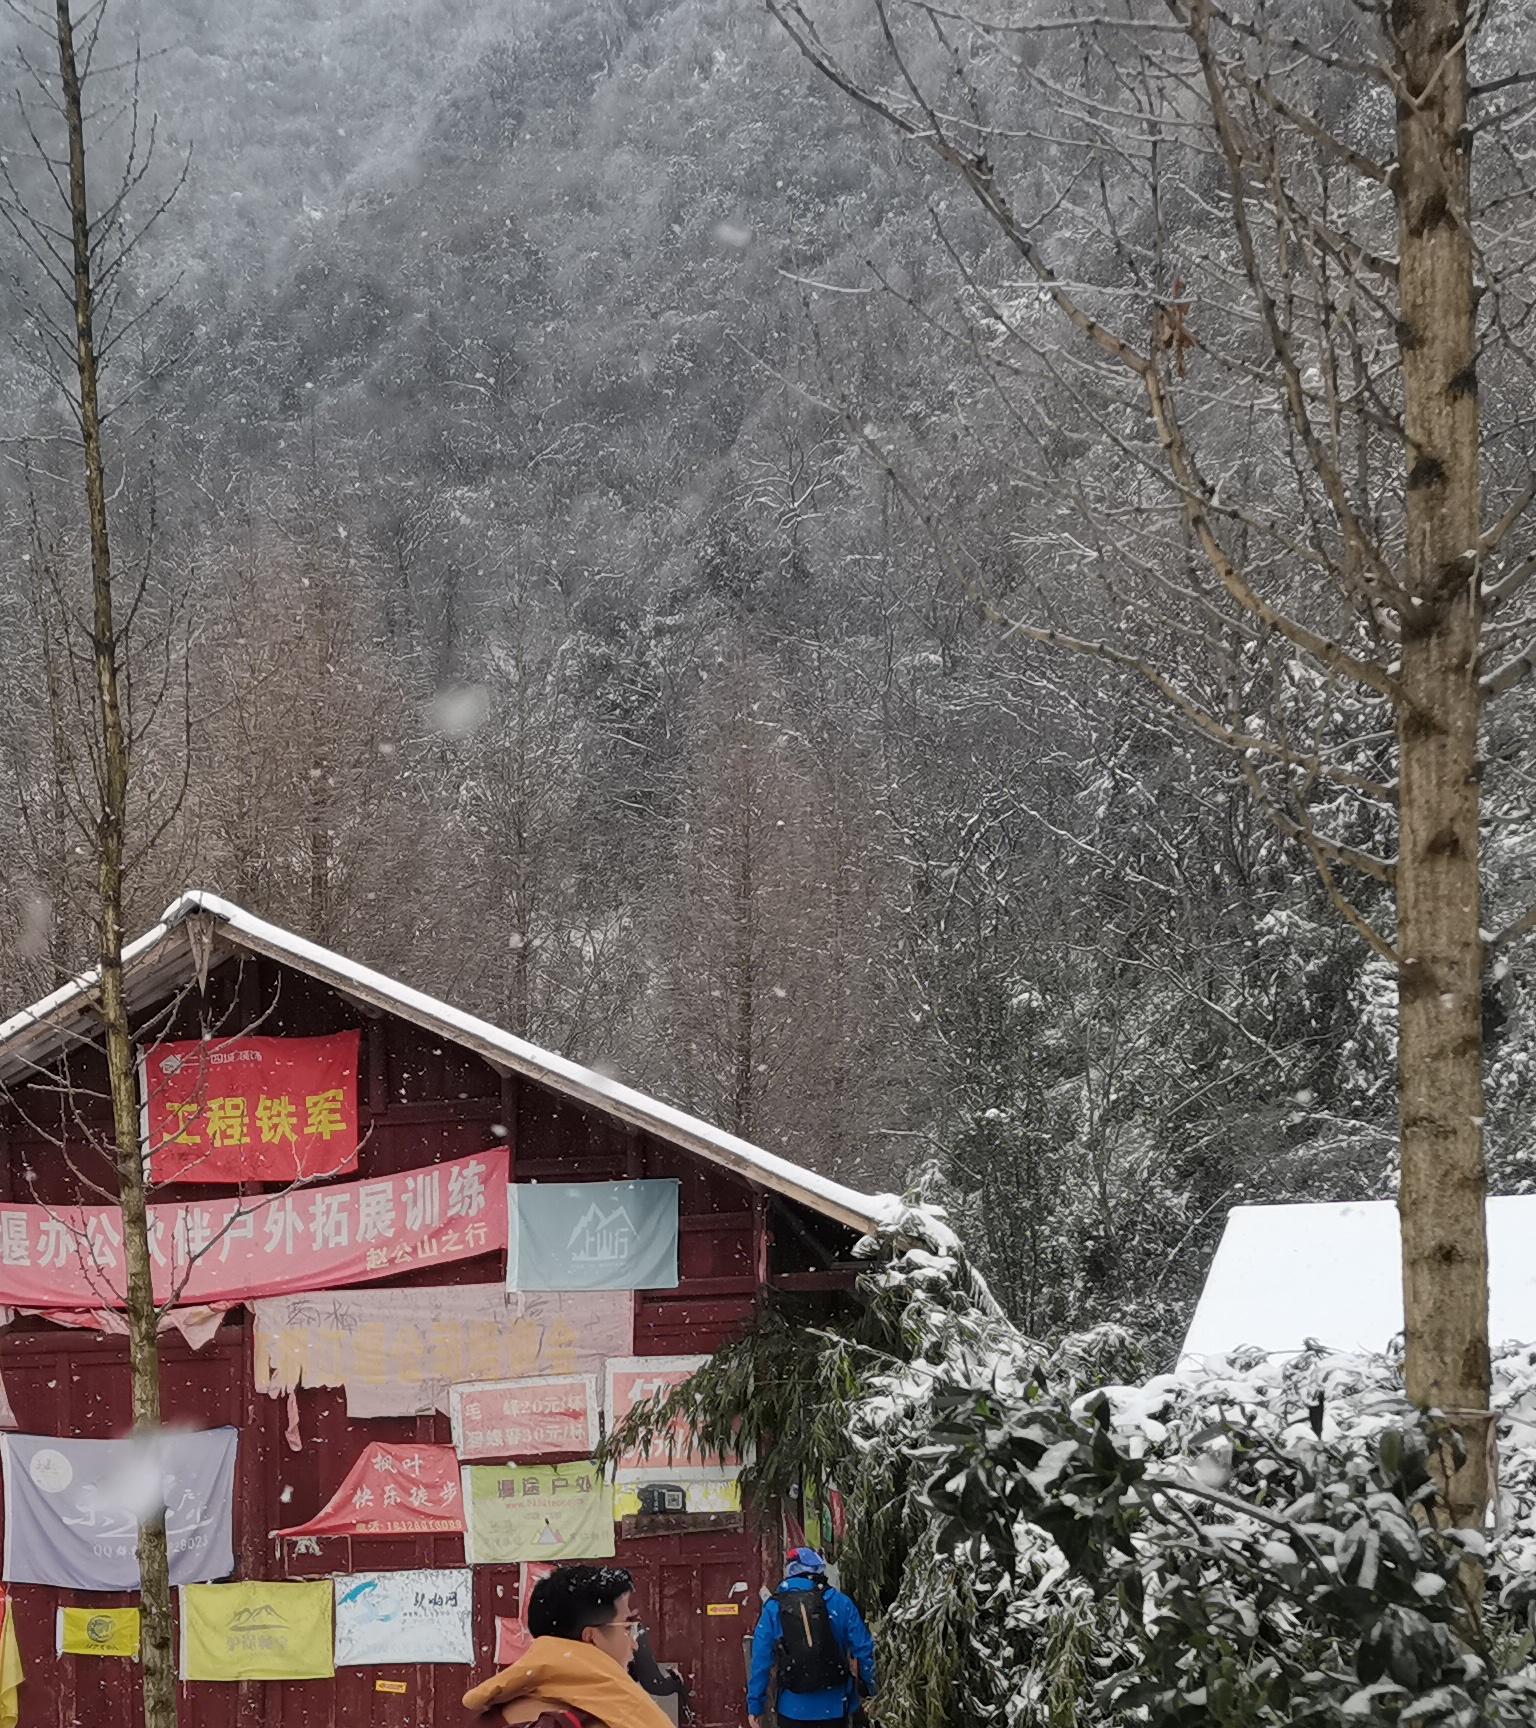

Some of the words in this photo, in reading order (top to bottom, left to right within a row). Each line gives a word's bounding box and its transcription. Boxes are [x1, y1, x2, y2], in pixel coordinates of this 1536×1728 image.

[162, 1088, 348, 1148] 工程铁军
[366, 1220, 489, 1271] 赵公山之行
[371, 1452, 424, 1478] 枫叶
[352, 1479, 459, 1510] 快乐徒步
